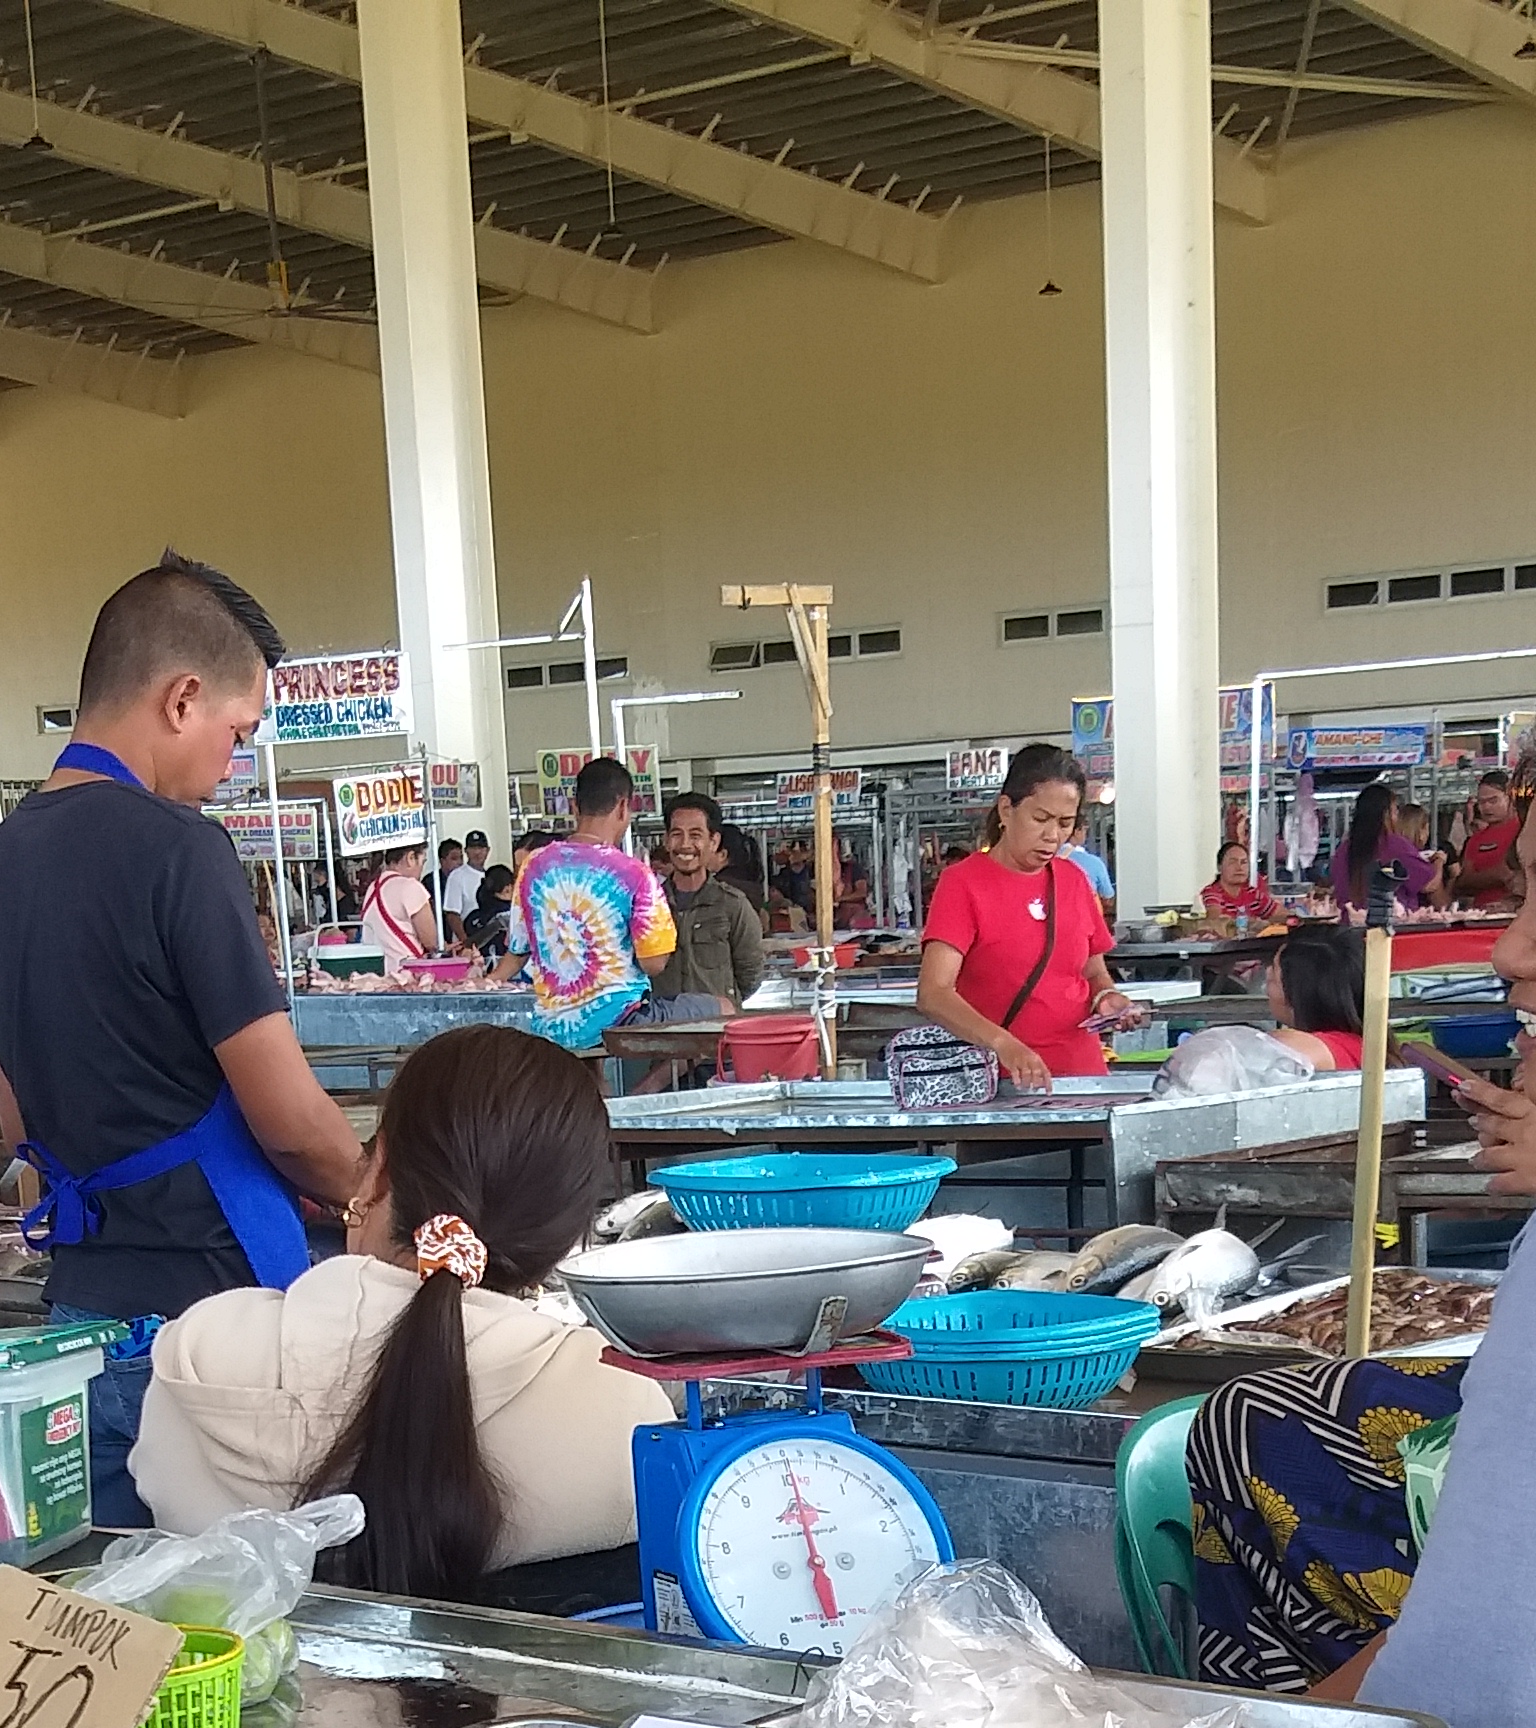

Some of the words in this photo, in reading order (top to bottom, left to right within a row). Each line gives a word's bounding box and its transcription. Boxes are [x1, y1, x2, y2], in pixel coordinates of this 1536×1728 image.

[273, 656, 401, 704] PRINCESS
[275, 702, 333, 727] DRESSED
[336, 696, 394, 723] CHICKEN
[355, 774, 425, 818] DODIE
[224, 814, 312, 829] MALOU
[359, 813, 399, 838] CHICKEN
[741, 1495, 751, 1509] 9
[879, 1520, 889, 1533] 2
[721, 1541, 731, 1555] 8
[737, 1595, 745, 1609] 7
[25, 1587, 132, 1670] TUMPOK
[779, 1632, 790, 1646] 6
[832, 1641, 843, 1655] 5
